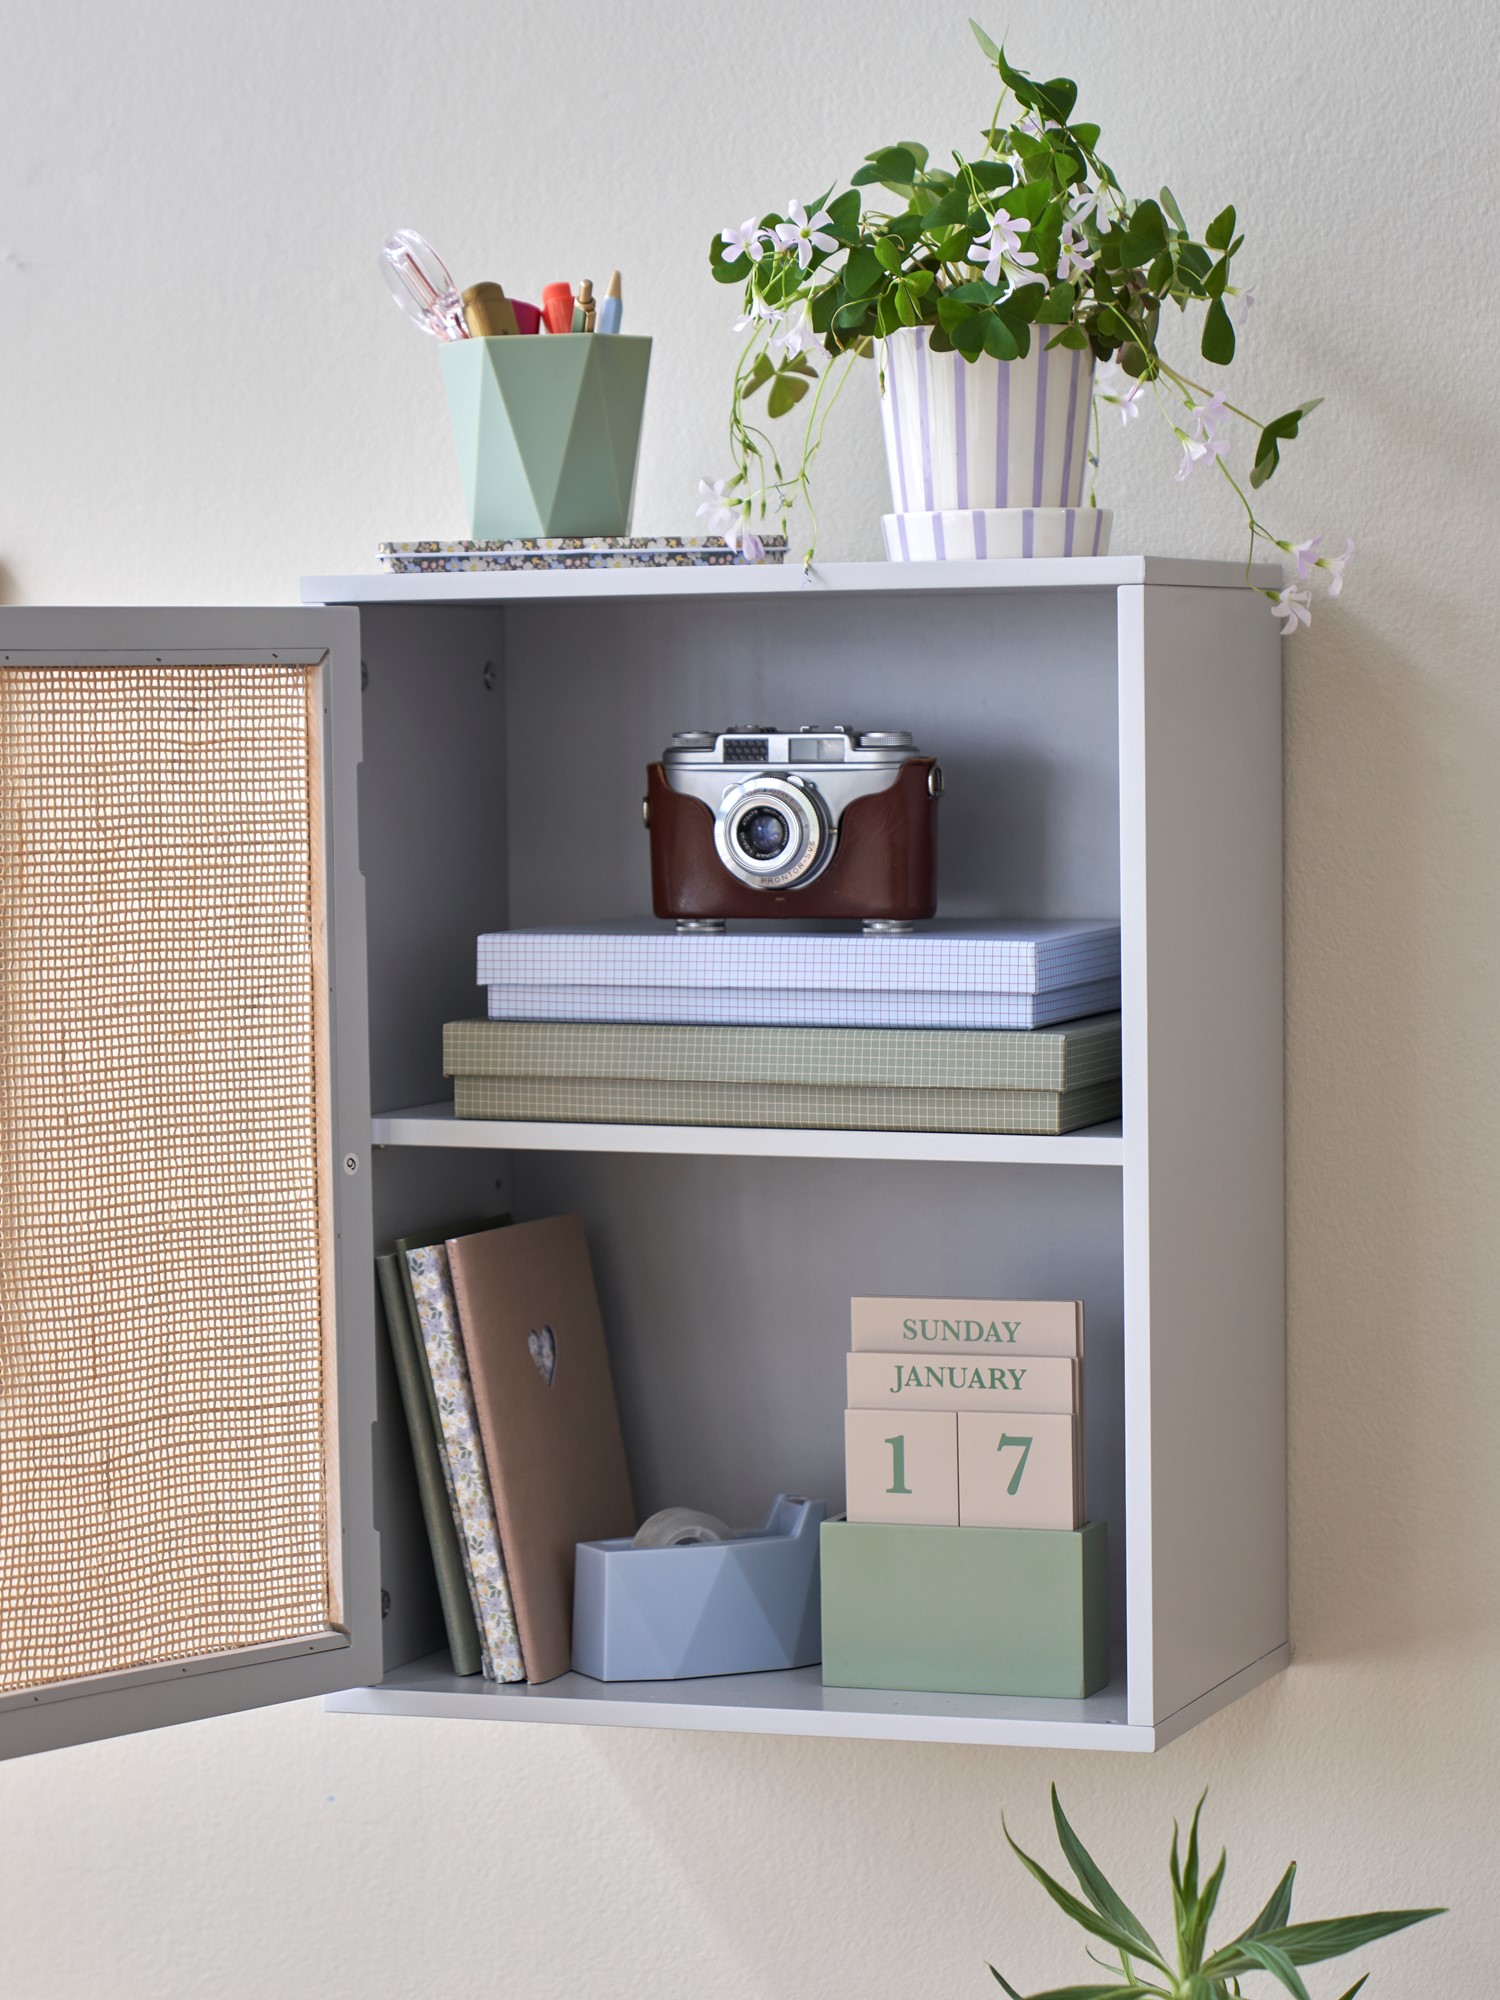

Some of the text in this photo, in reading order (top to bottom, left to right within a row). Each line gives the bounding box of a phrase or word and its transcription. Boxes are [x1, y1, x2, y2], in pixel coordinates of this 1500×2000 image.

[904, 1319, 1021, 1343] SUNDAY
[889, 1365, 1027, 1393] JANUARY
[884, 1433, 1033, 1496] 1 7
